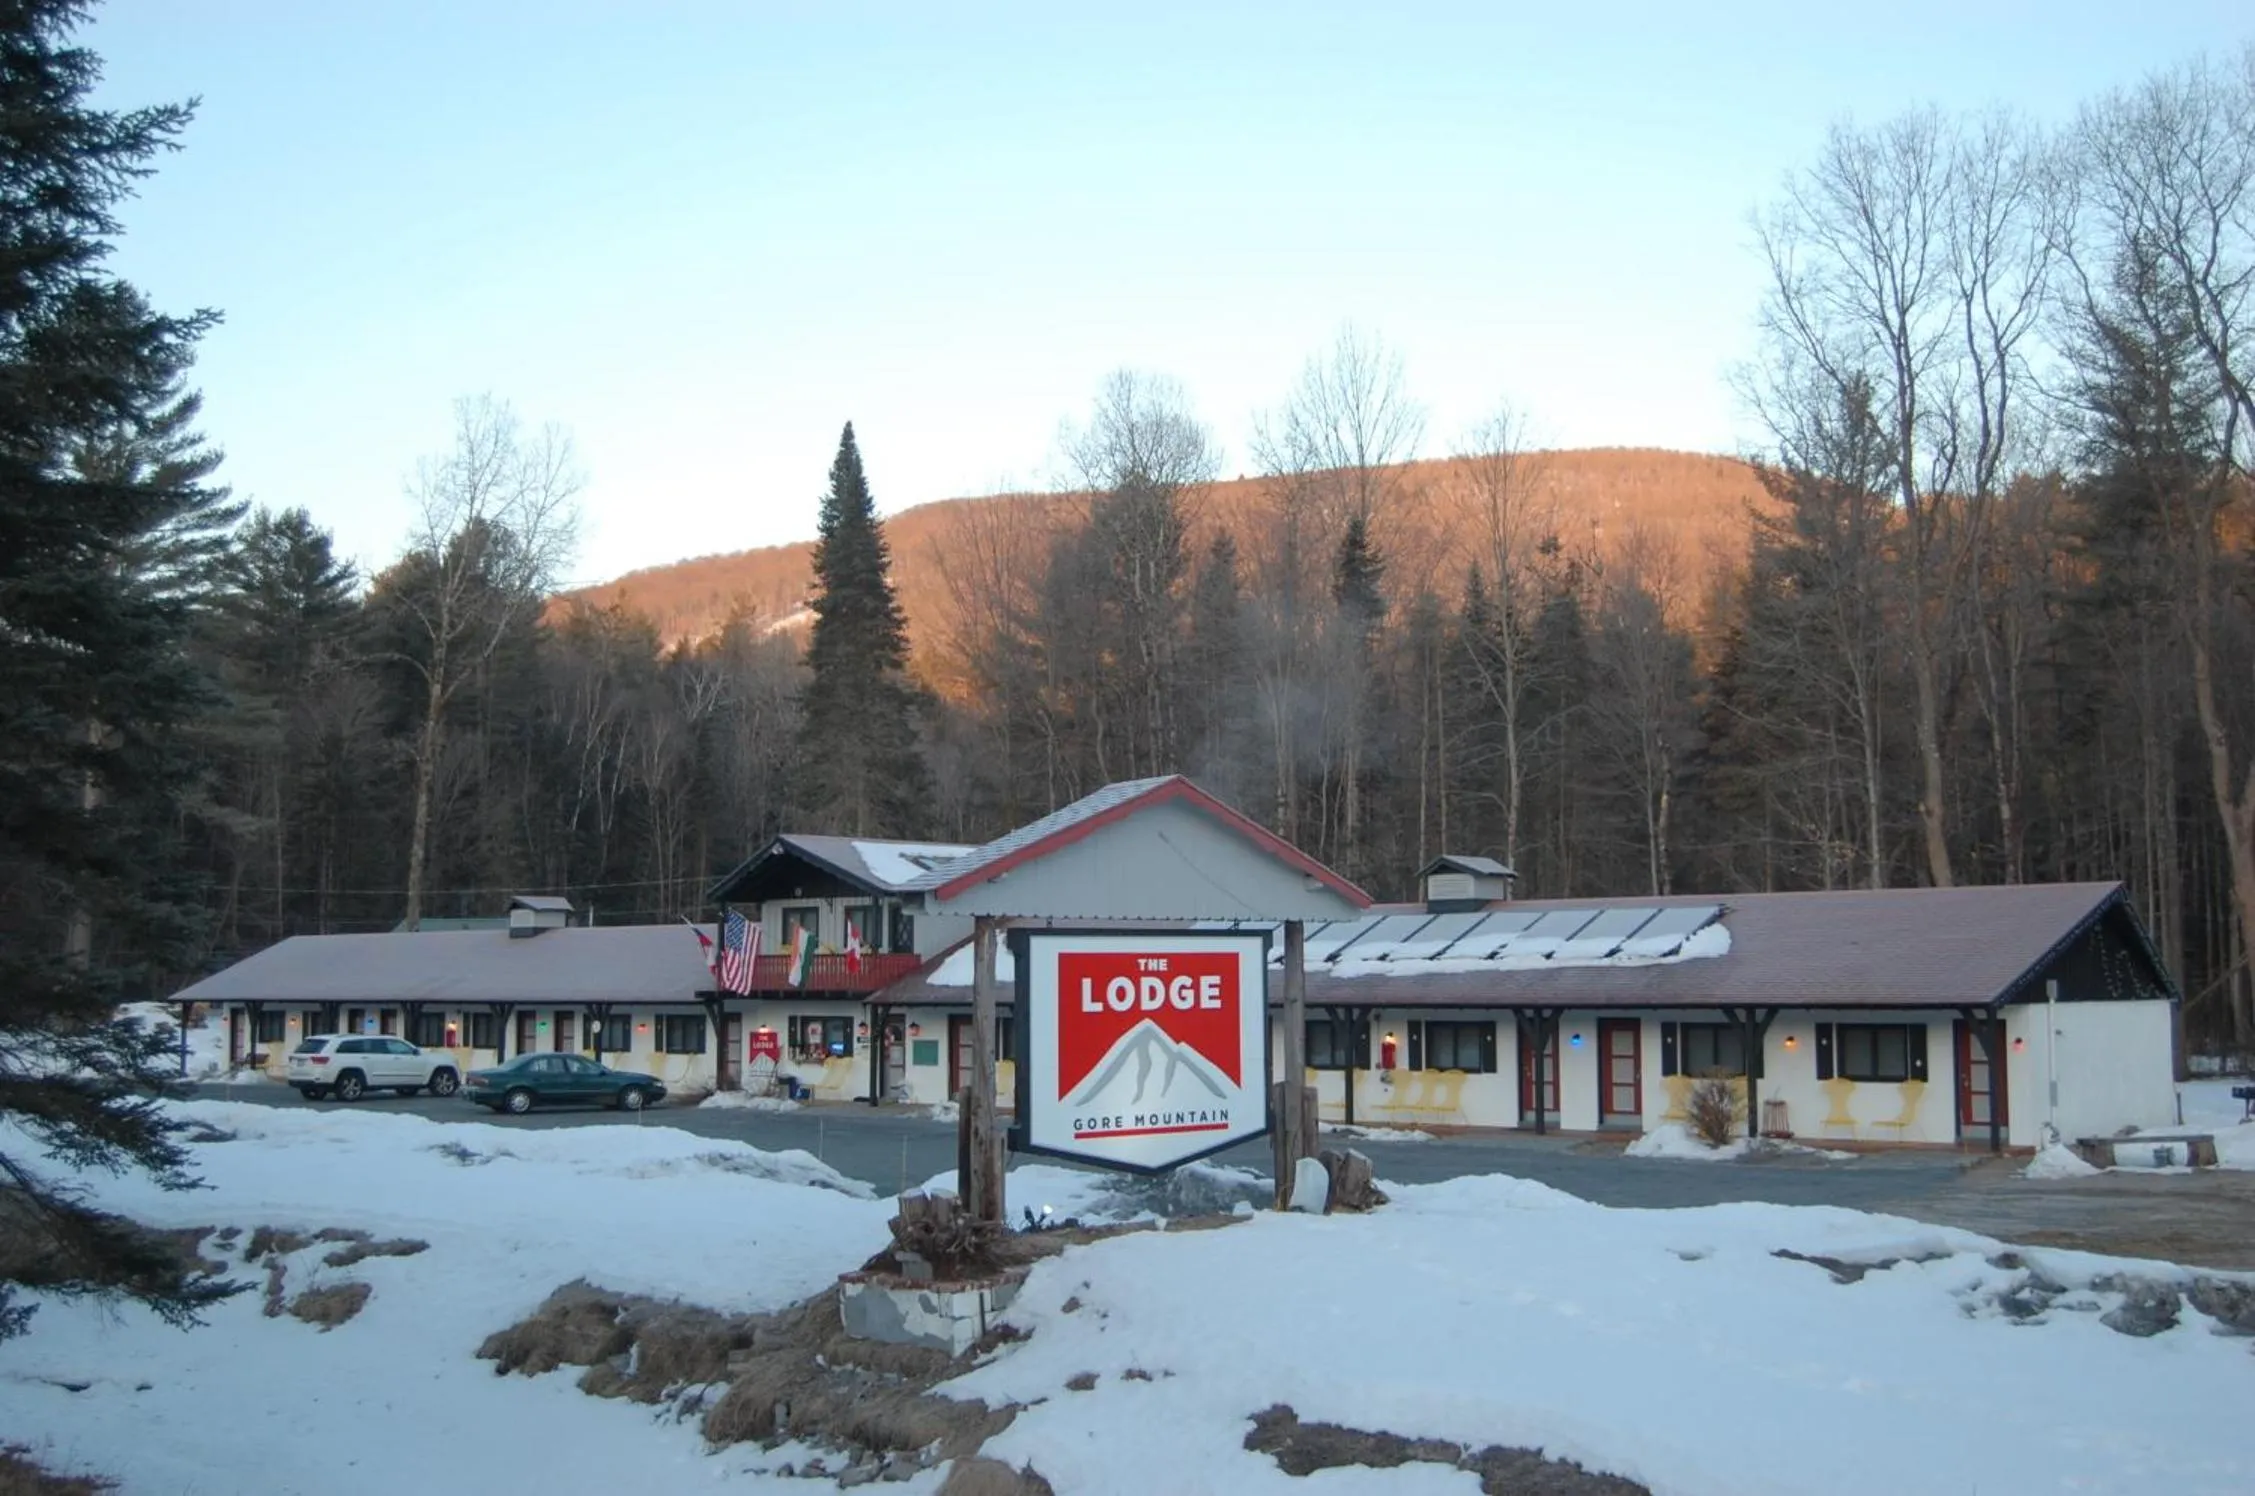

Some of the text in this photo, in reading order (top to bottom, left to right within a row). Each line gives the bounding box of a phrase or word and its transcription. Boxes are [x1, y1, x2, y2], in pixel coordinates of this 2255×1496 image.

[1137, 958, 1168, 971] THE
[1081, 975, 1222, 1013] LODGE
[1074, 1109, 1229, 1131] GORE MOUNTAIN
